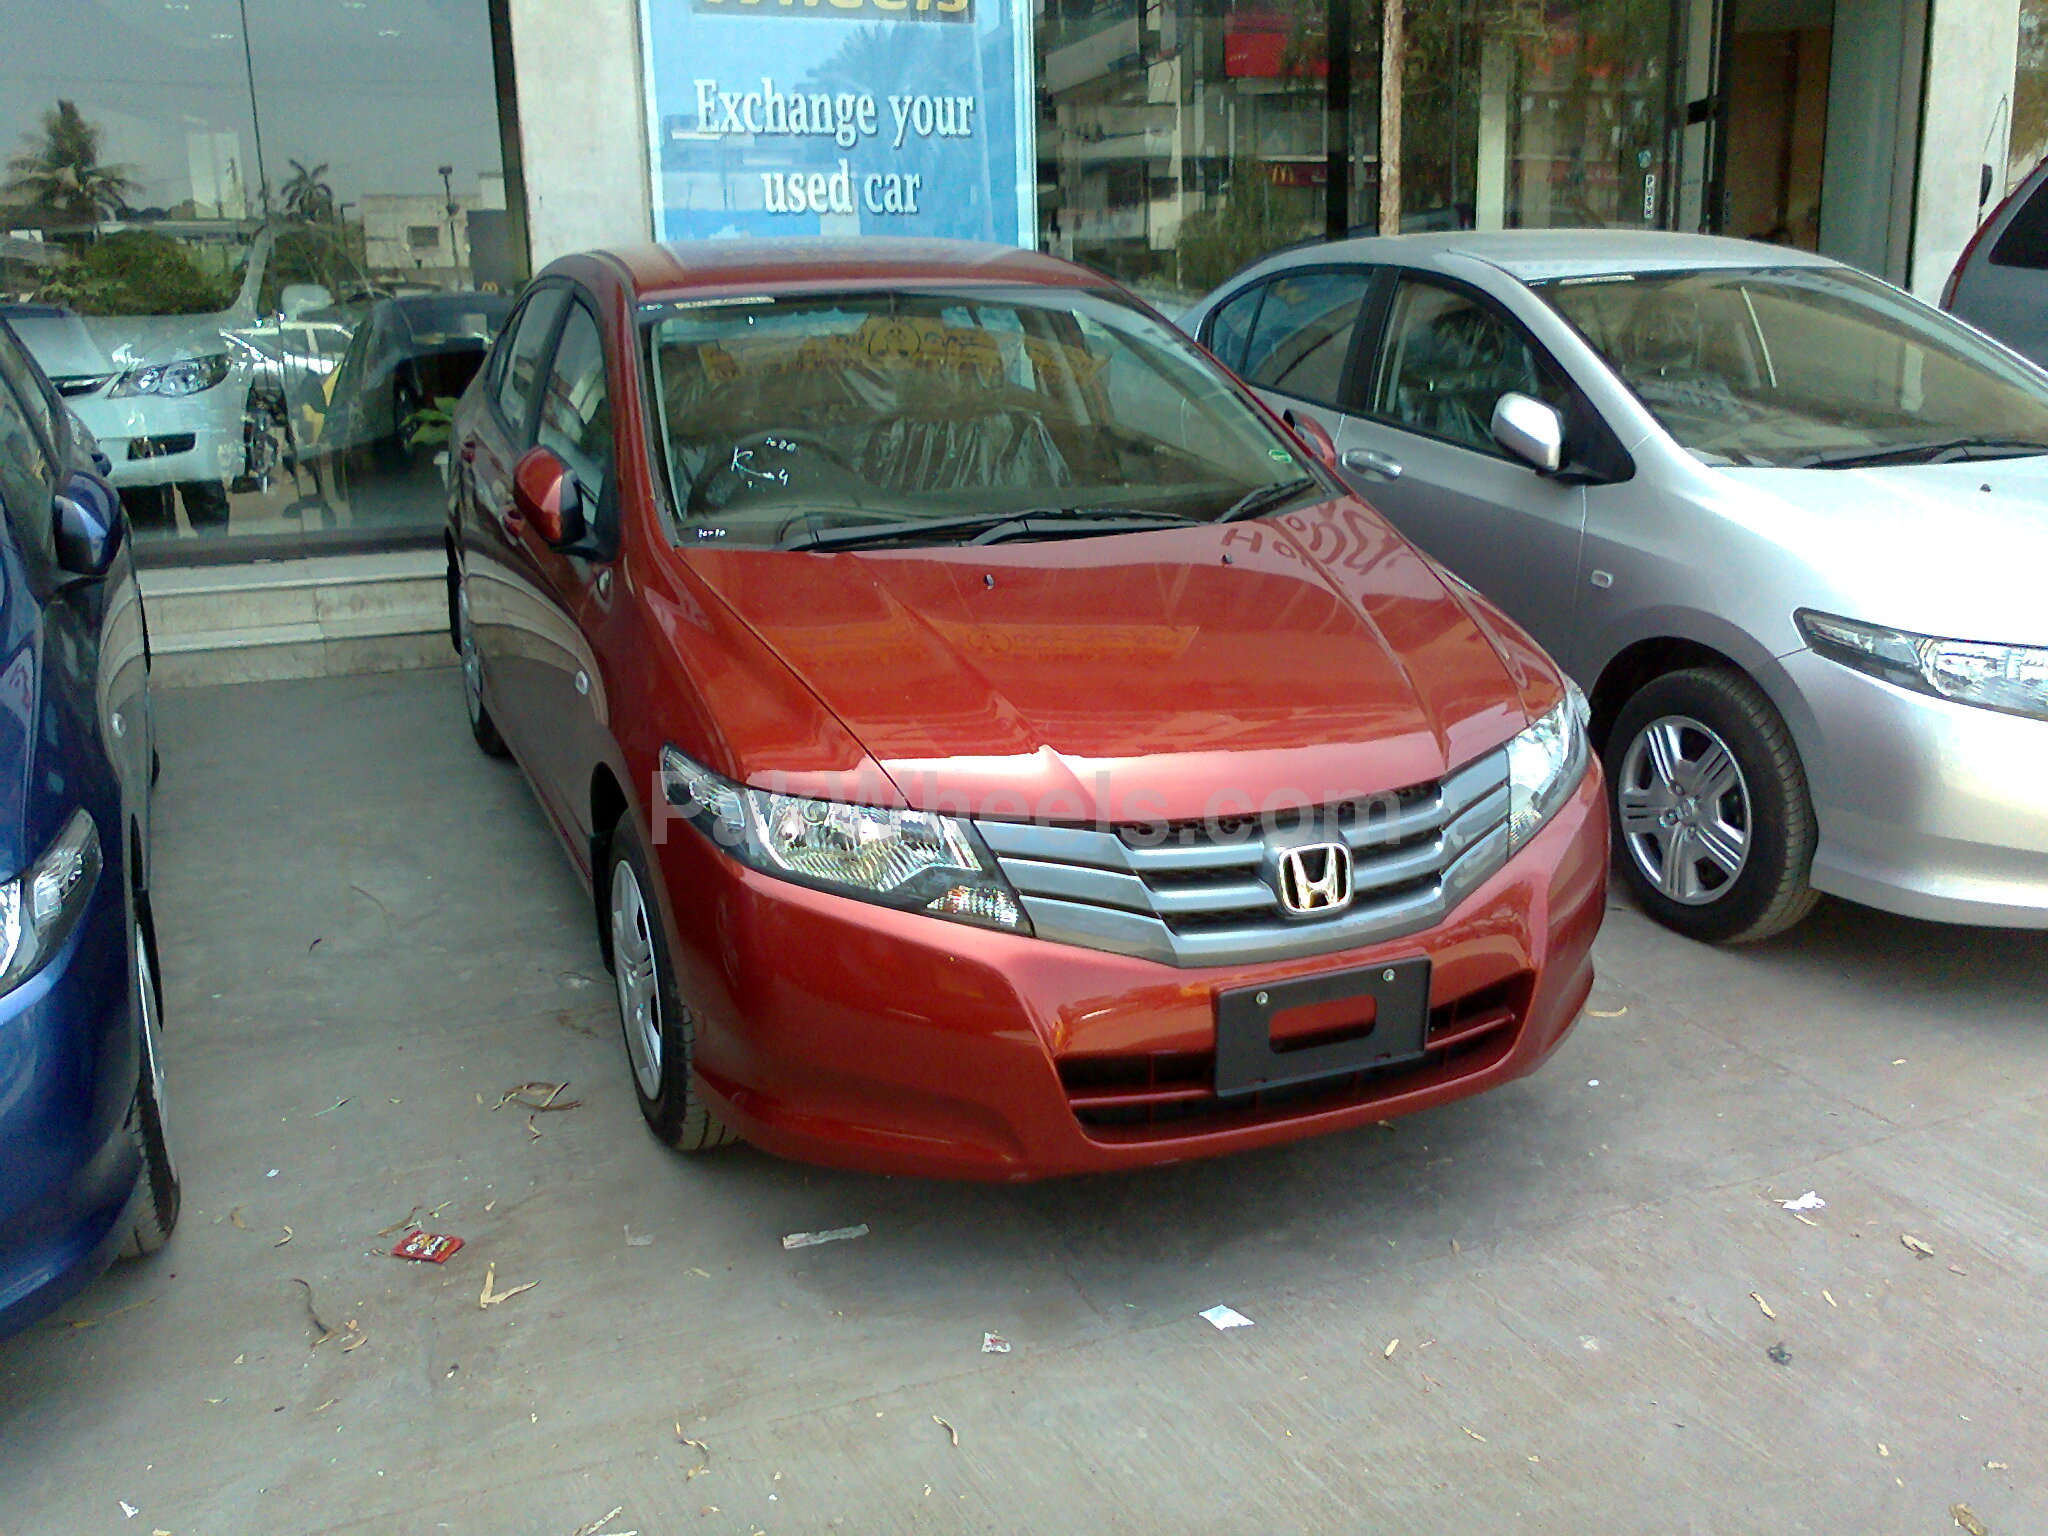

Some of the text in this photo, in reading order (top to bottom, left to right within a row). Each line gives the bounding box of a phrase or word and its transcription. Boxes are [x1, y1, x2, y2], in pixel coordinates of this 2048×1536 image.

[694, 78, 975, 148] Exchange your
[761, 159, 921, 214] used car
